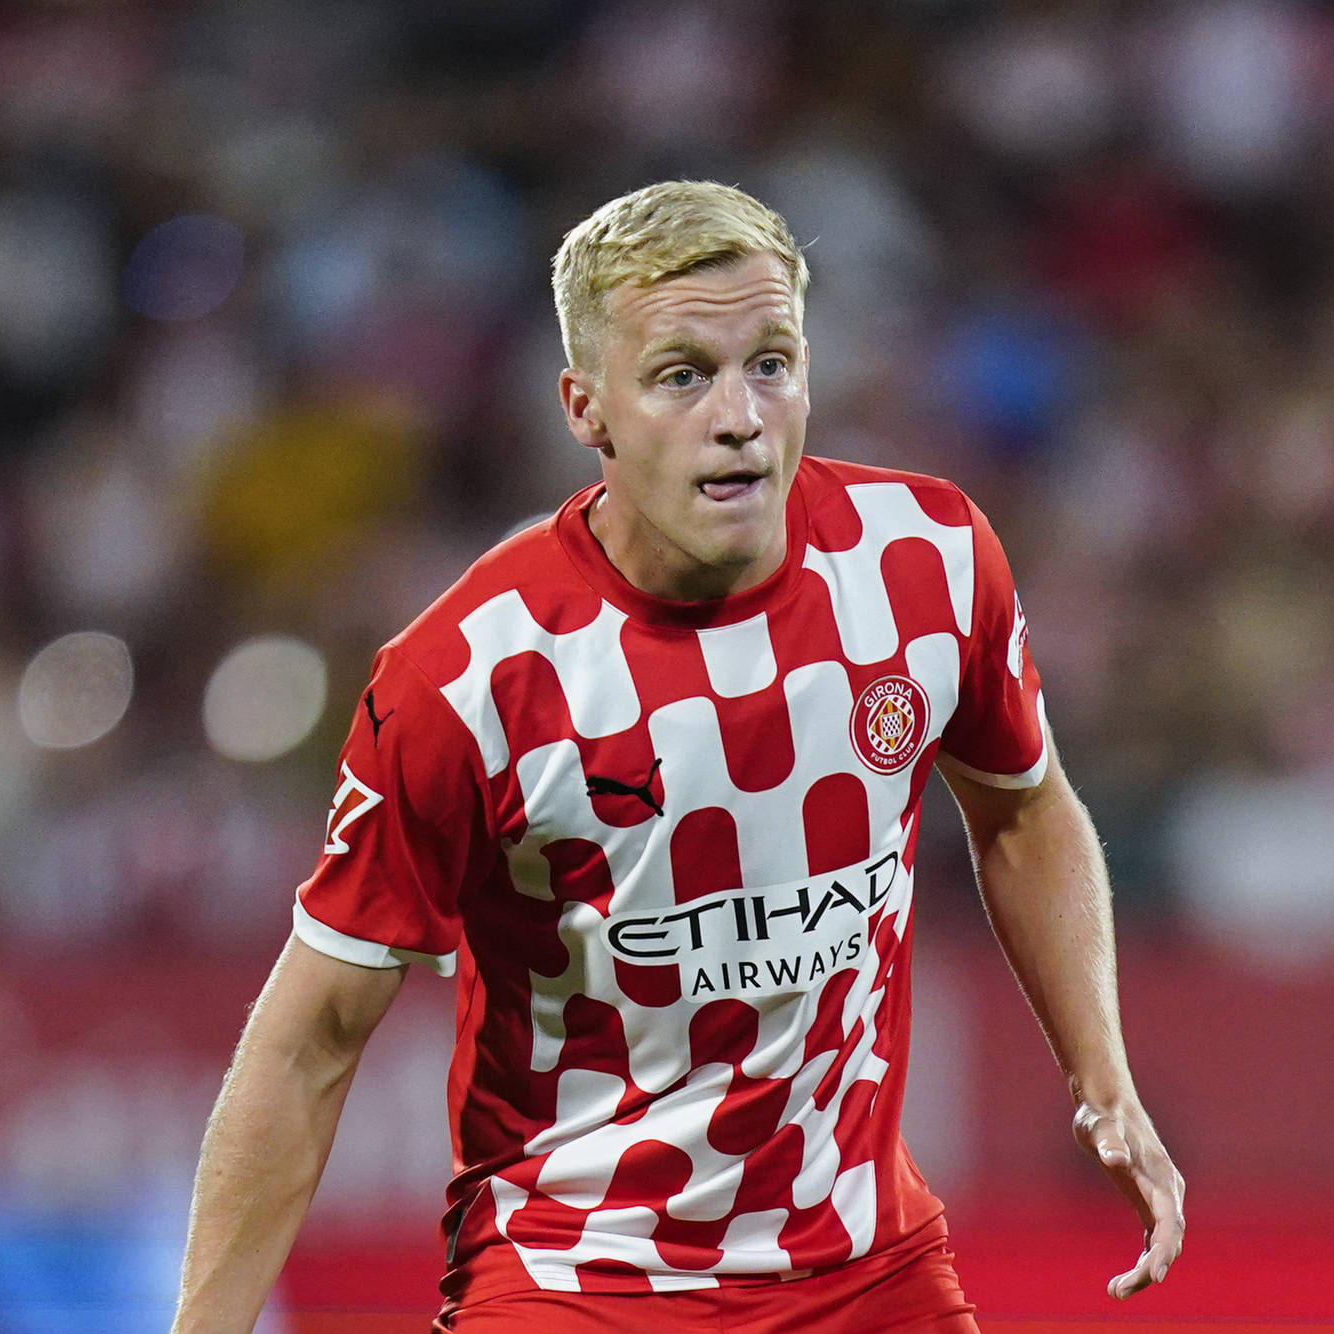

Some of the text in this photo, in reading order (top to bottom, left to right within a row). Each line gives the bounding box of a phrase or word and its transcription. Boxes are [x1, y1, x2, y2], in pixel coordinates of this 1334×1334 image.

[864, 682, 913, 708] GIRONA
[608, 851, 898, 957] ETIHAD
[692, 933, 862, 996] AIRWAYS
